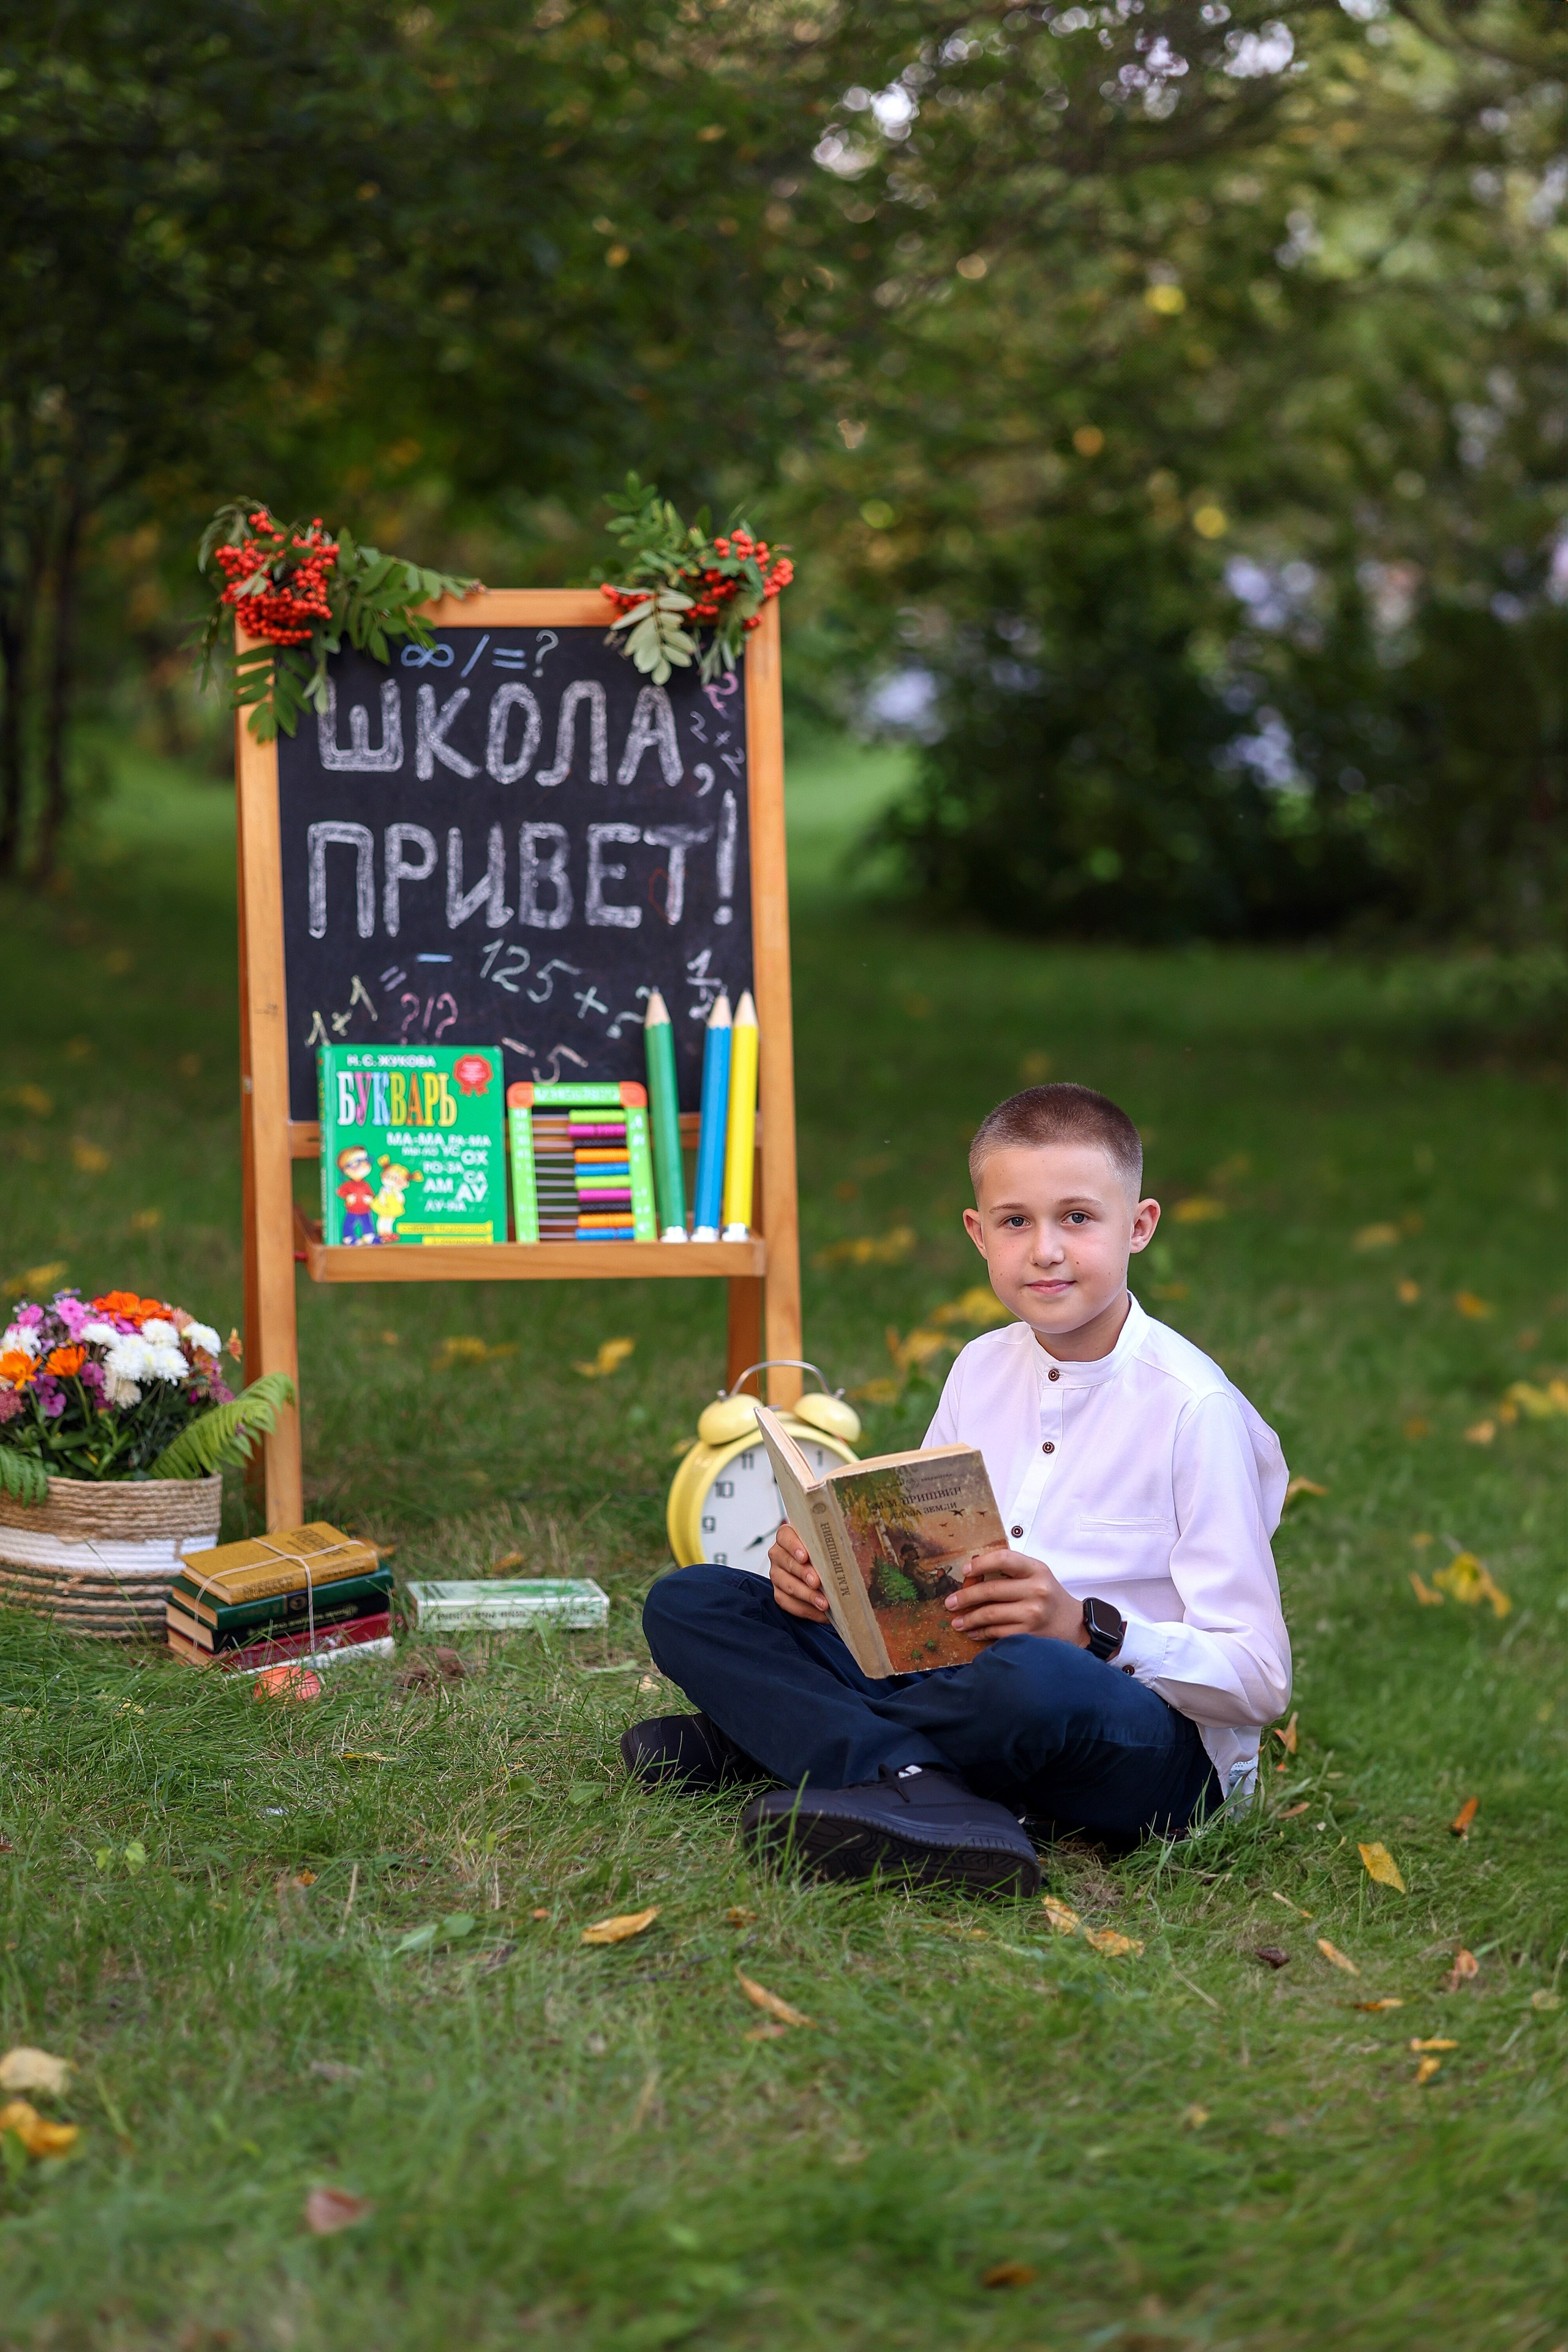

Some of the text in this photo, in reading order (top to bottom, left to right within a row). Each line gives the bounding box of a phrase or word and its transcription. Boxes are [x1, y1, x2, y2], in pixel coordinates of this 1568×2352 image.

[317, 676, 715, 797] ШКОЛА,
[307, 788, 737, 938] ПРИВЕТ!
[480, 938, 582, 1003] 125
[377, 1054, 437, 1068] ЖУКОВА
[337, 1071, 458, 1126] БУКВАРЬ
[423, 1177, 454, 1194] АМ
[455, 1183, 489, 1202] АУ
[741, 1452, 755, 1471] 11
[816, 1450, 824, 1466] 1
[714, 1480, 734, 1498] 10
[901, 1487, 962, 1505] ПРИШВИН
[923, 1502, 957, 1514] ЗЕМЛИ
[702, 1515, 716, 1534] 9
[820, 1522, 844, 1574] ПРИШВИН
